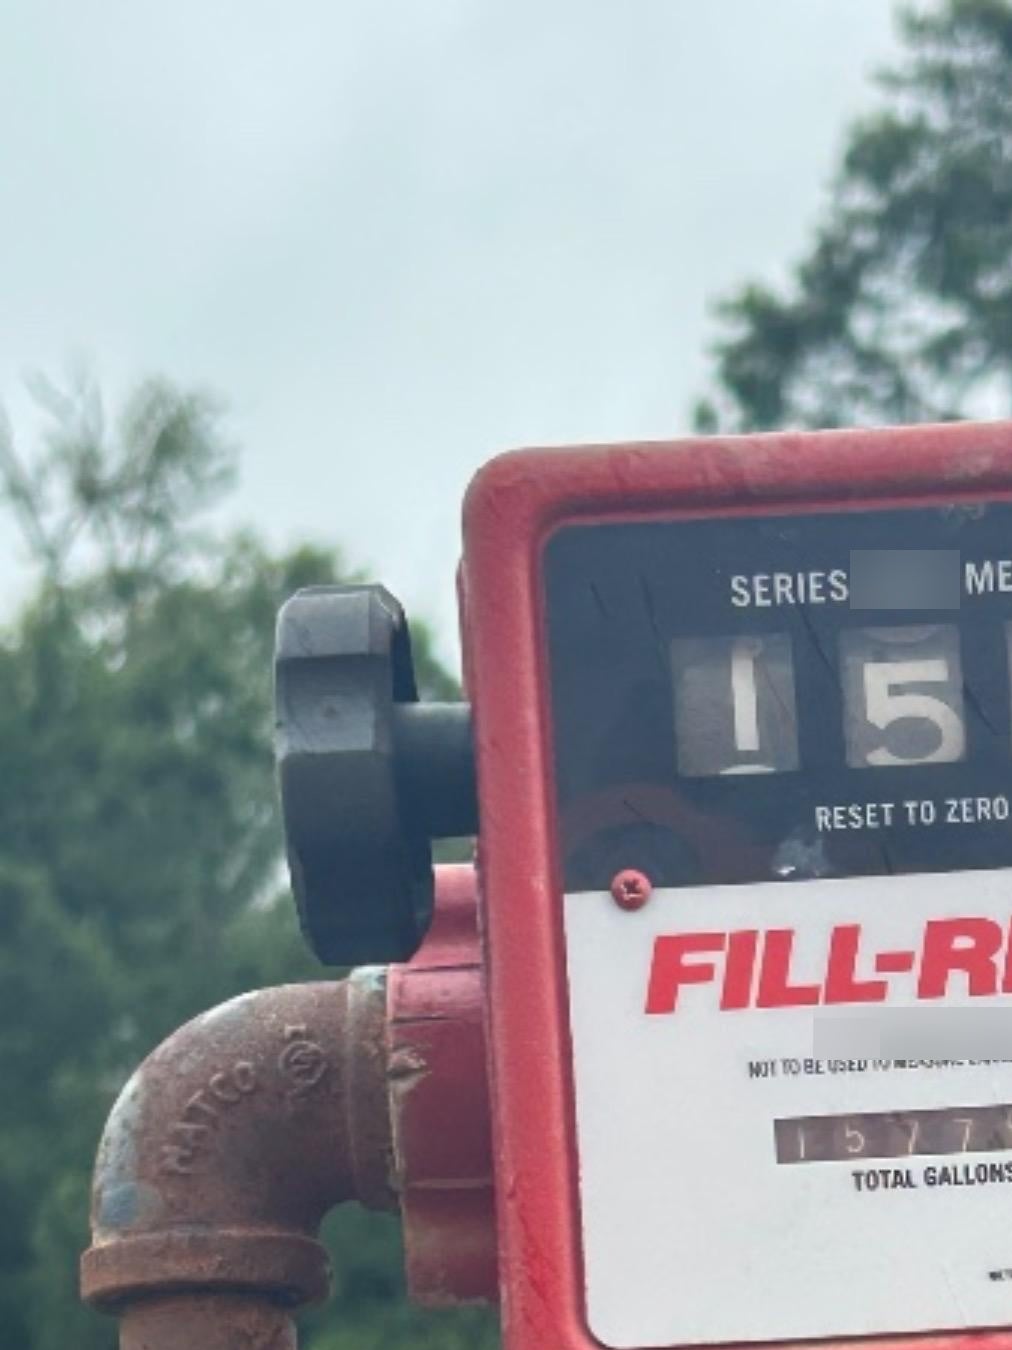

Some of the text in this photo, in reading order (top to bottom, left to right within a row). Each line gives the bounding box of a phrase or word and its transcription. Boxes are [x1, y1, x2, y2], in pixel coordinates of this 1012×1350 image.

[731, 569, 850, 607] SERIES
[815, 796, 1010, 831] RESET TO ZERO
[781, 1058, 801, 1075] TO
[804, 1058, 825, 1074] BE
[852, 1168, 917, 1191] TOTAL
